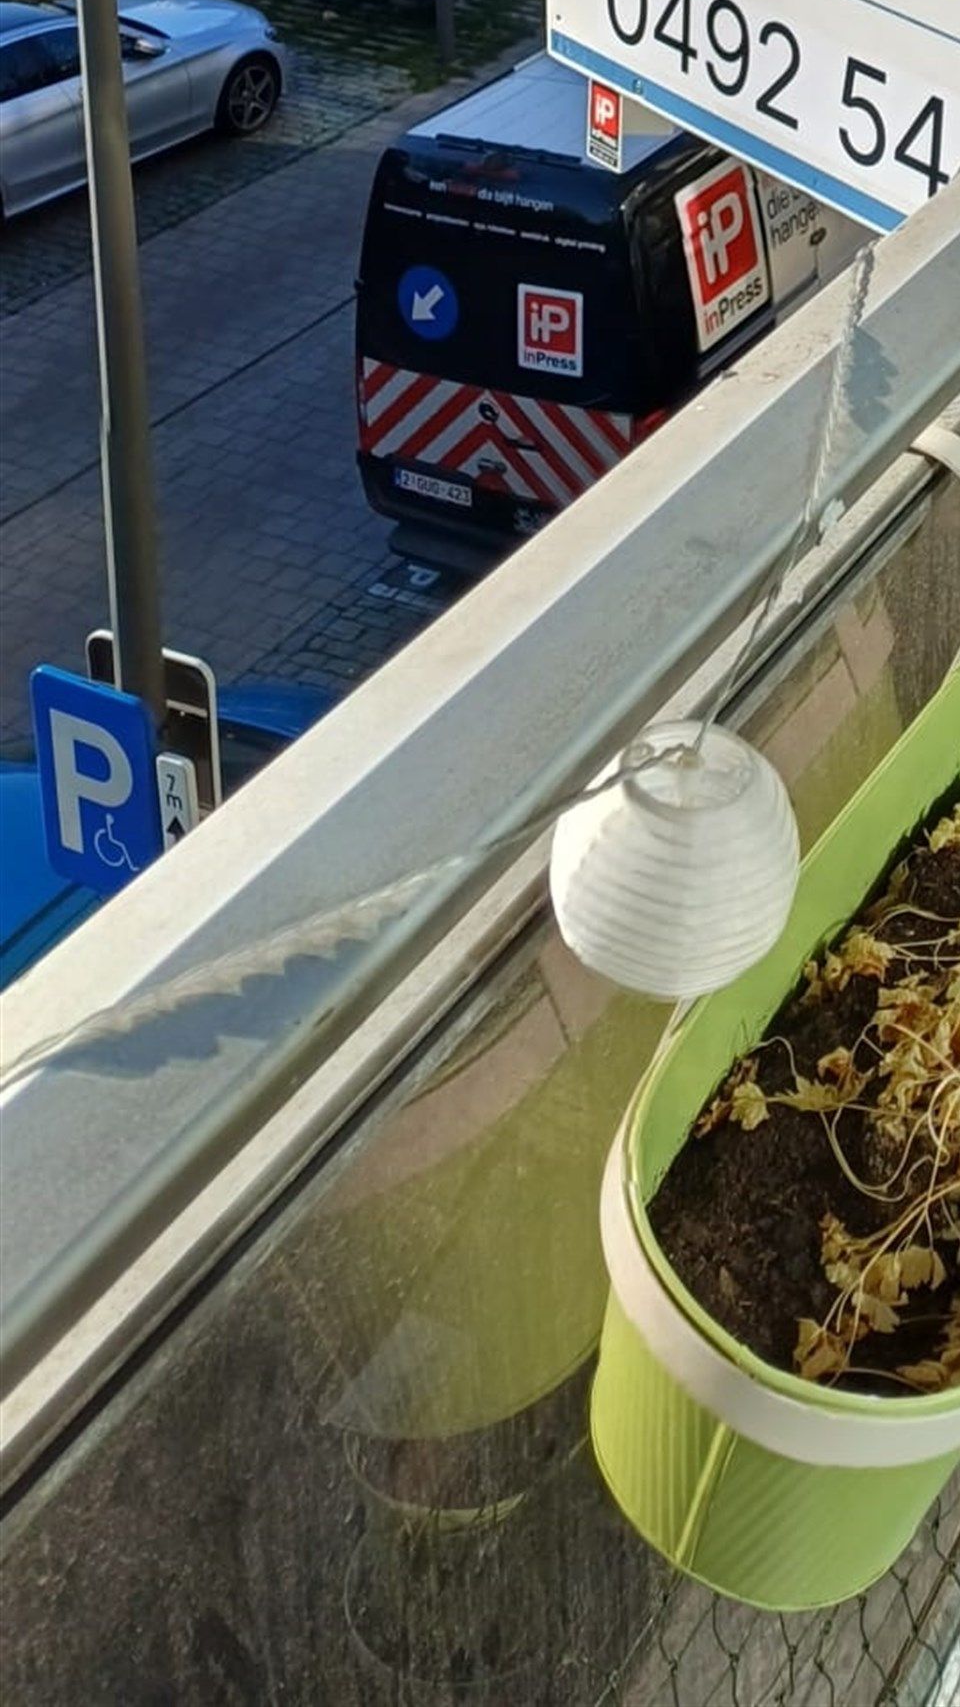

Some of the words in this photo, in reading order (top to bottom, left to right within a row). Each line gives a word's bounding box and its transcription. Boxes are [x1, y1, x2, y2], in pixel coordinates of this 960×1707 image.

[838, 57, 950, 200] 54
[704, 277, 763, 334] inPress
[524, 348, 577, 371] inPress
[49, 707, 134, 854] P
